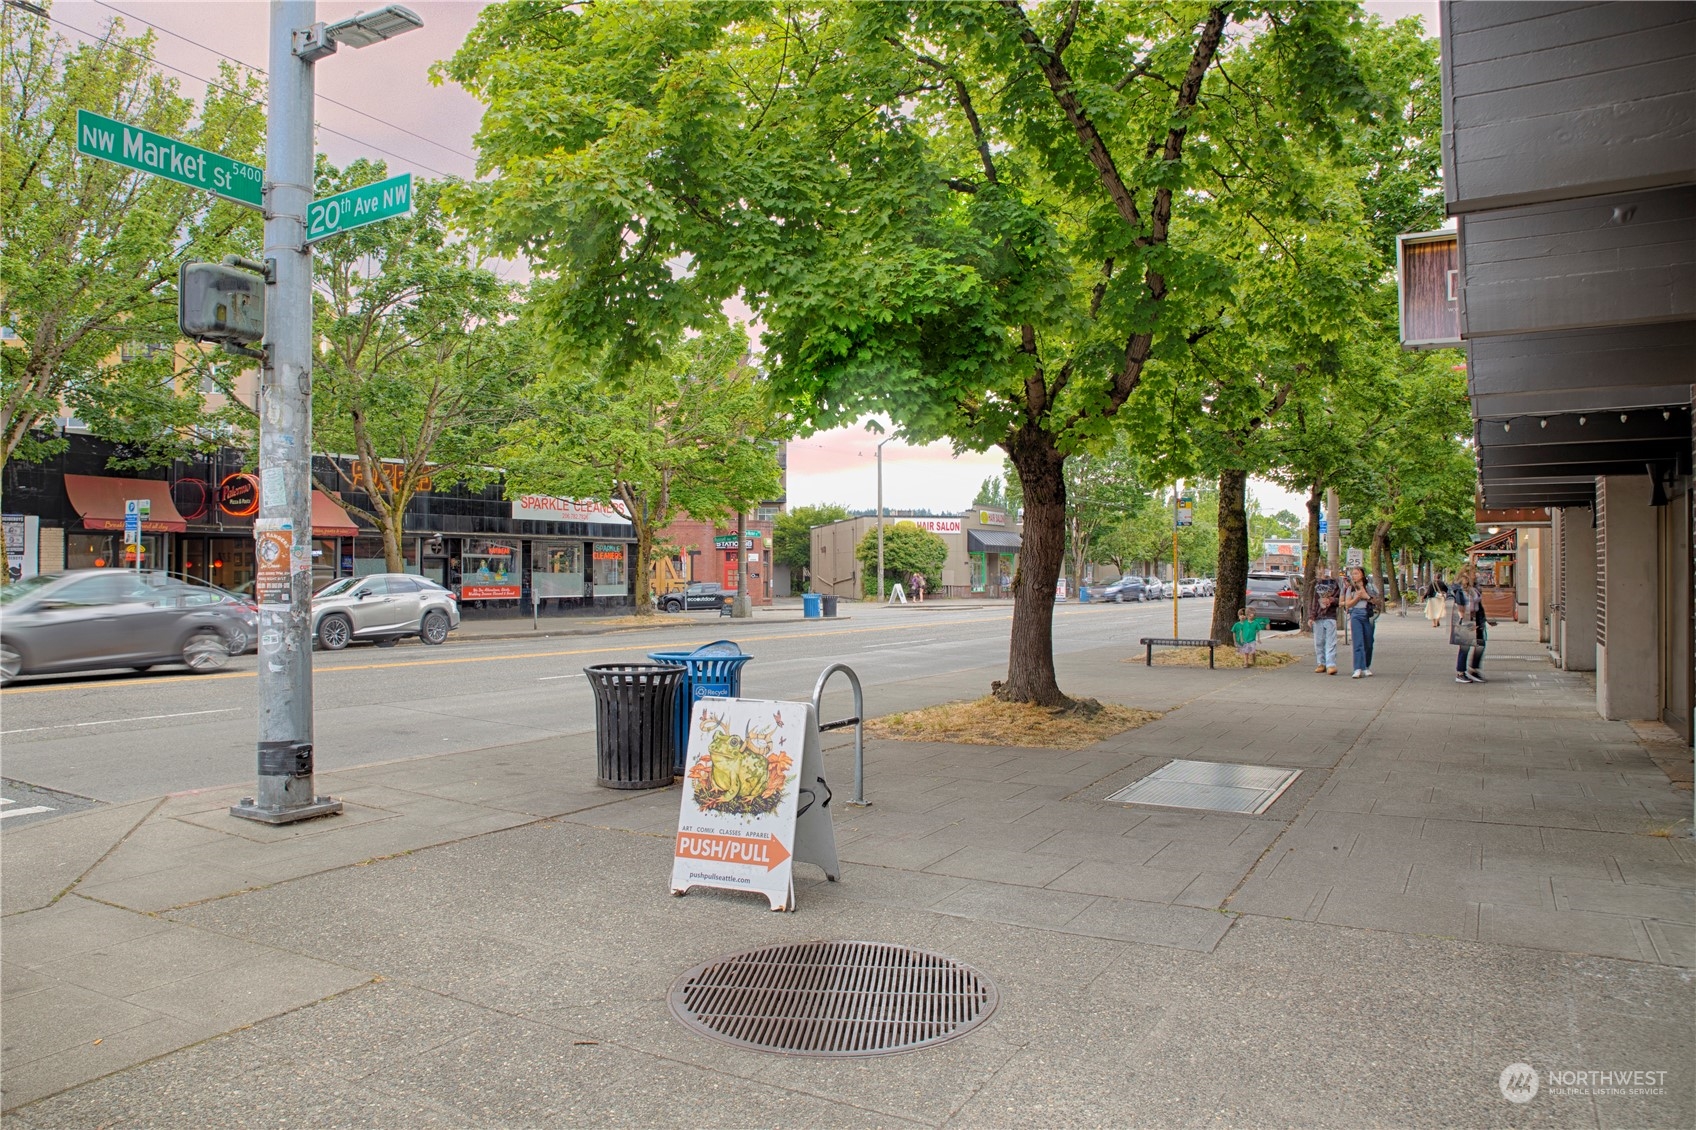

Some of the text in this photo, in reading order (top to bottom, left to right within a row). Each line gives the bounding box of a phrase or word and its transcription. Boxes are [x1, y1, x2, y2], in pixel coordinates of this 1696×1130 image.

[82, 124, 232, 190] NW Market St
[232, 162, 261, 183] 5400
[310, 183, 408, 235] 20th Ave NW
[520, 495, 569, 511] SPARKLE
[916, 521, 960, 531] HAIR SALON
[595, 544, 621, 552] SPARKLE
[593, 552, 623, 560] CLEANERS
[1349, 558, 1361, 566] 25
[707, 689, 728, 697] Recycle
[696, 826, 715, 834] COMIX
[719, 828, 741, 836] CLASSES
[745, 831, 770, 839] APPAREL
[679, 837, 770, 863] PUSH/PULL
[689, 872, 751, 884] pushpullseattle.com
